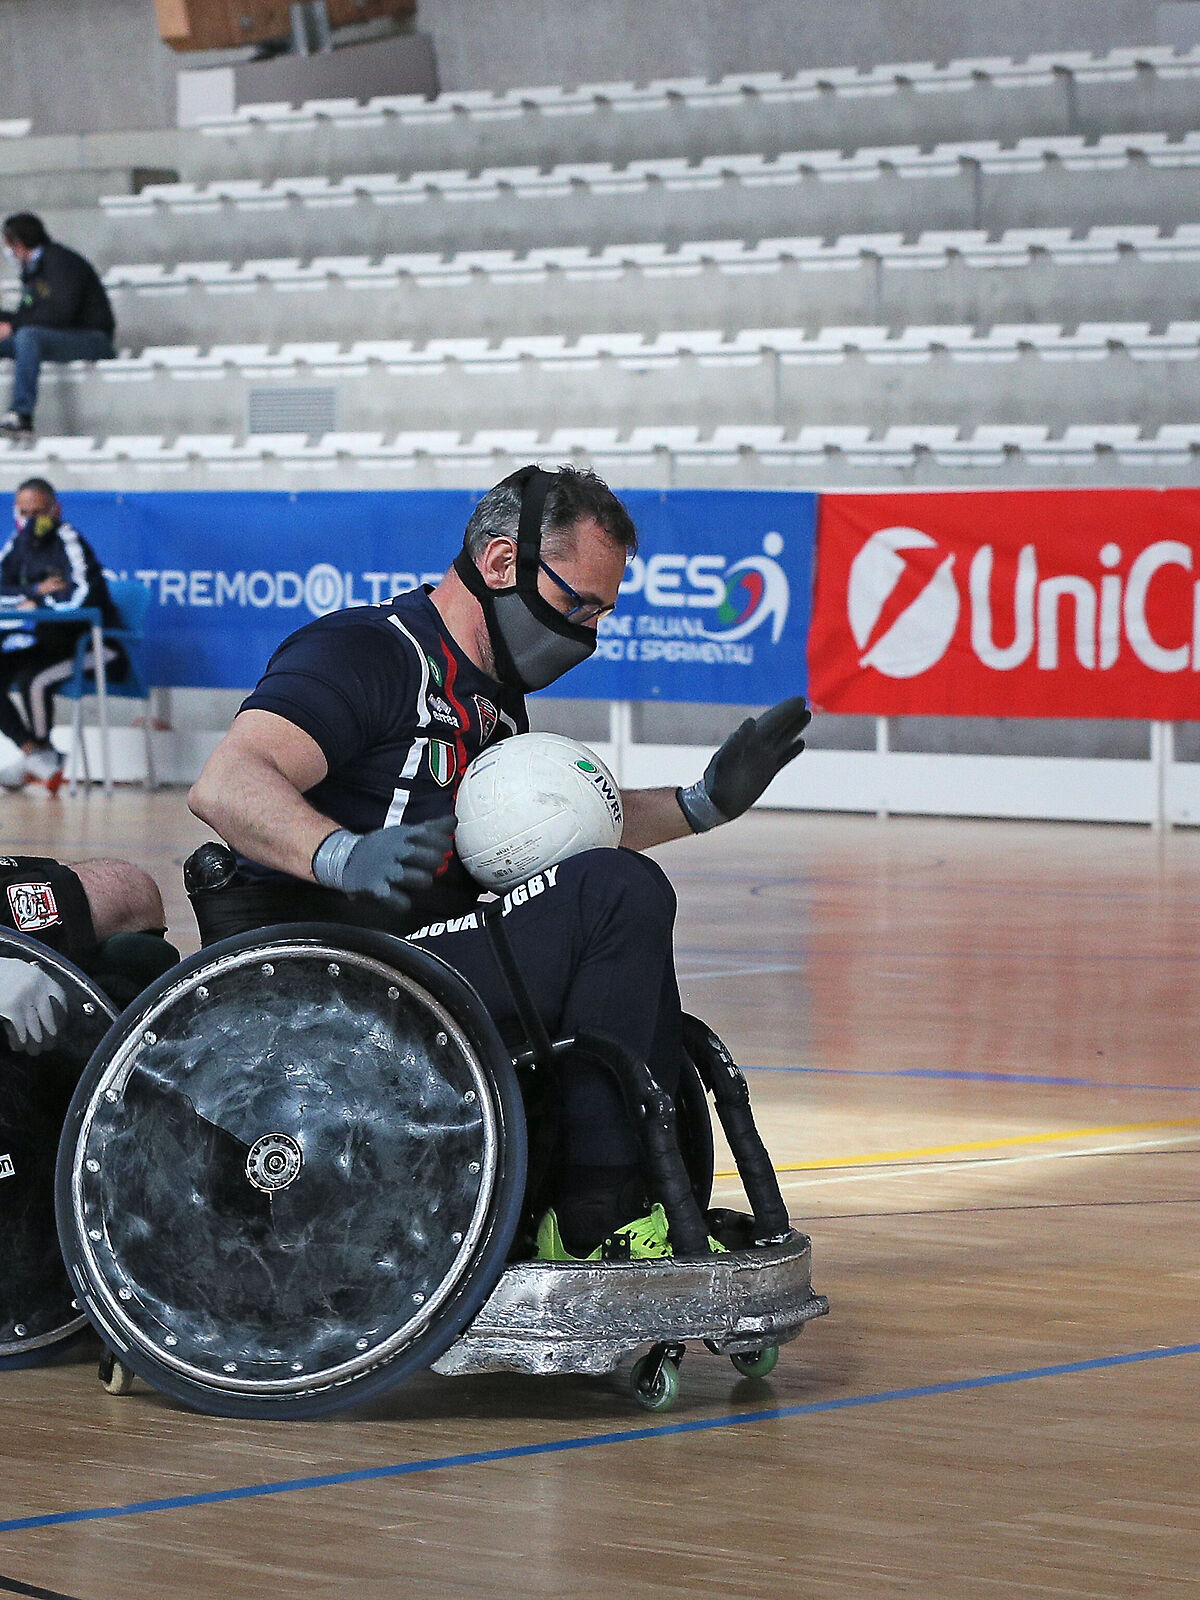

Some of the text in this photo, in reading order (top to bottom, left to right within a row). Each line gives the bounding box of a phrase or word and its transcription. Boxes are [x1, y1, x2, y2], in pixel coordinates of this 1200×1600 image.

[619, 554, 726, 608] PES
[969, 540, 1200, 673] UniC
[594, 775, 623, 824] IWRF
